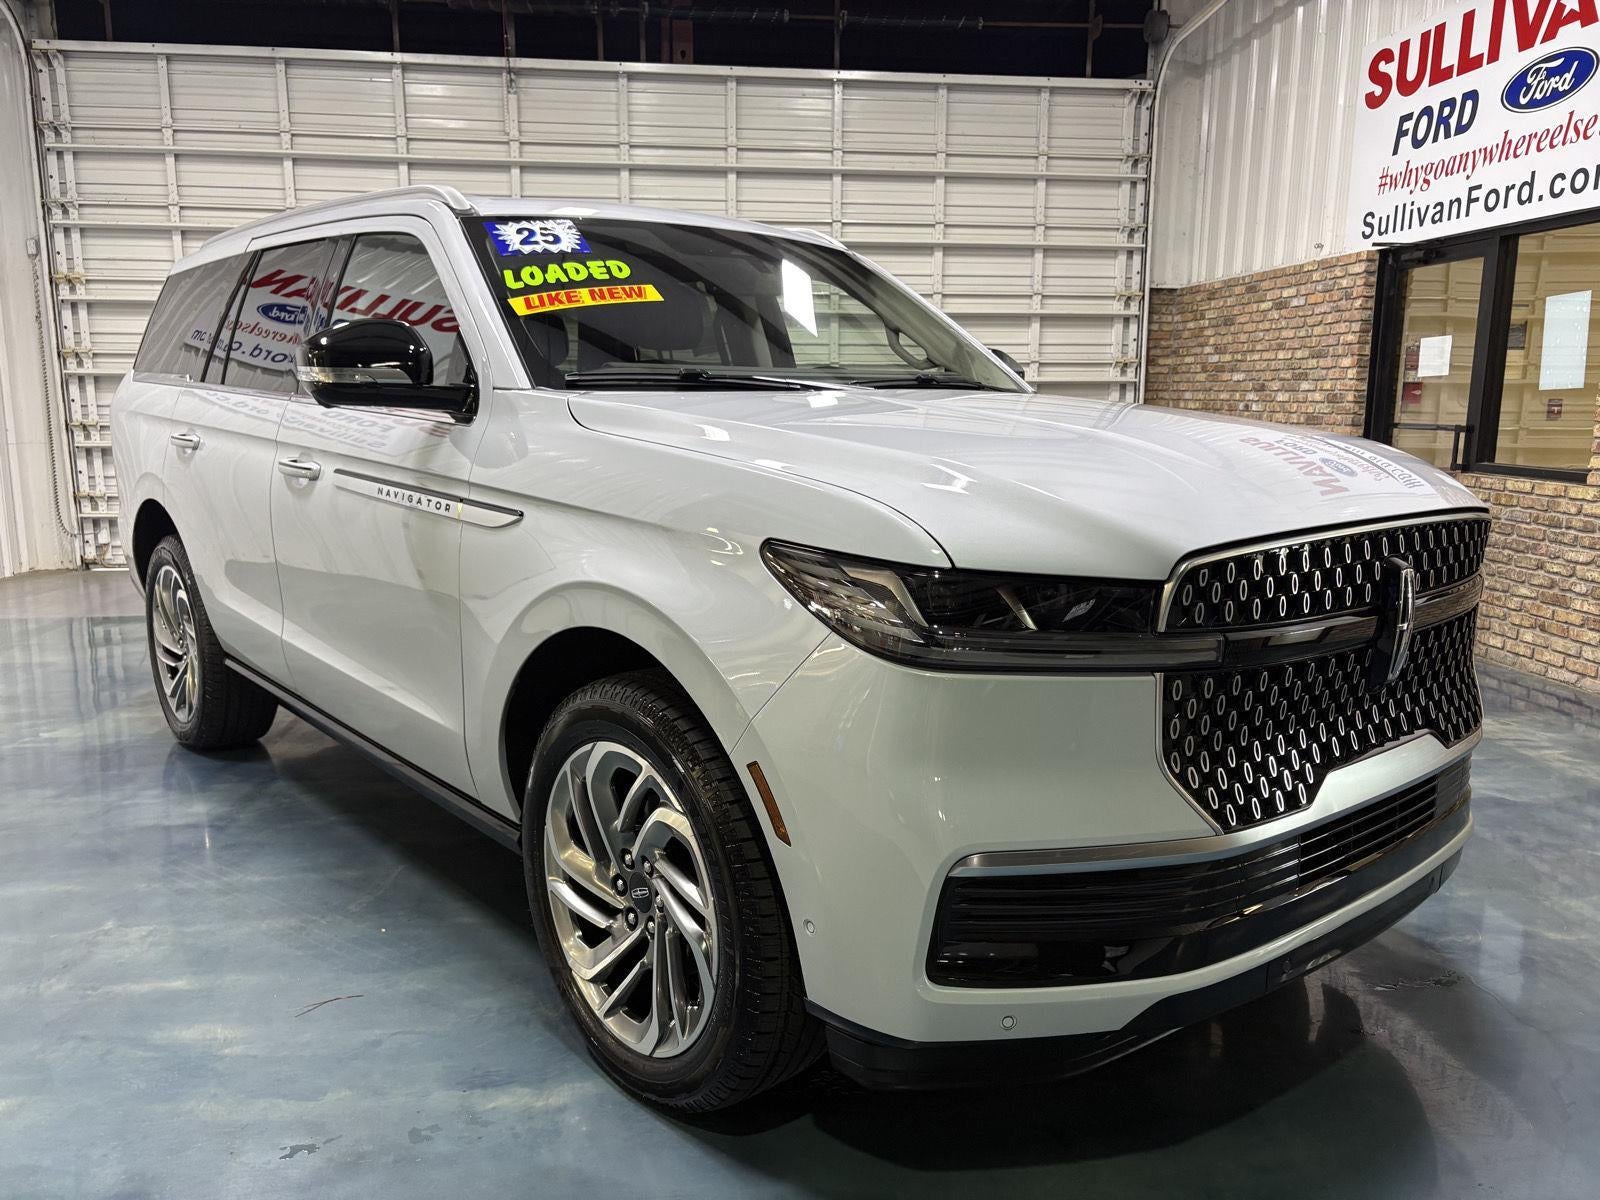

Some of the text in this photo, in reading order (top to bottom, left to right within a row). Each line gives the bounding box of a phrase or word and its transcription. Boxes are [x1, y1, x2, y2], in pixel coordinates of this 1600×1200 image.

[1519, 57, 1580, 105] Ford
[1392, 89, 1480, 156] FORD
[1378, 110, 1600, 196] #whygoanywhereelse
[515, 226, 563, 246] 25
[503, 260, 631, 289] LOADED
[523, 285, 645, 310] LIKE NEW
[377, 486, 451, 513] NAVIGATOR
